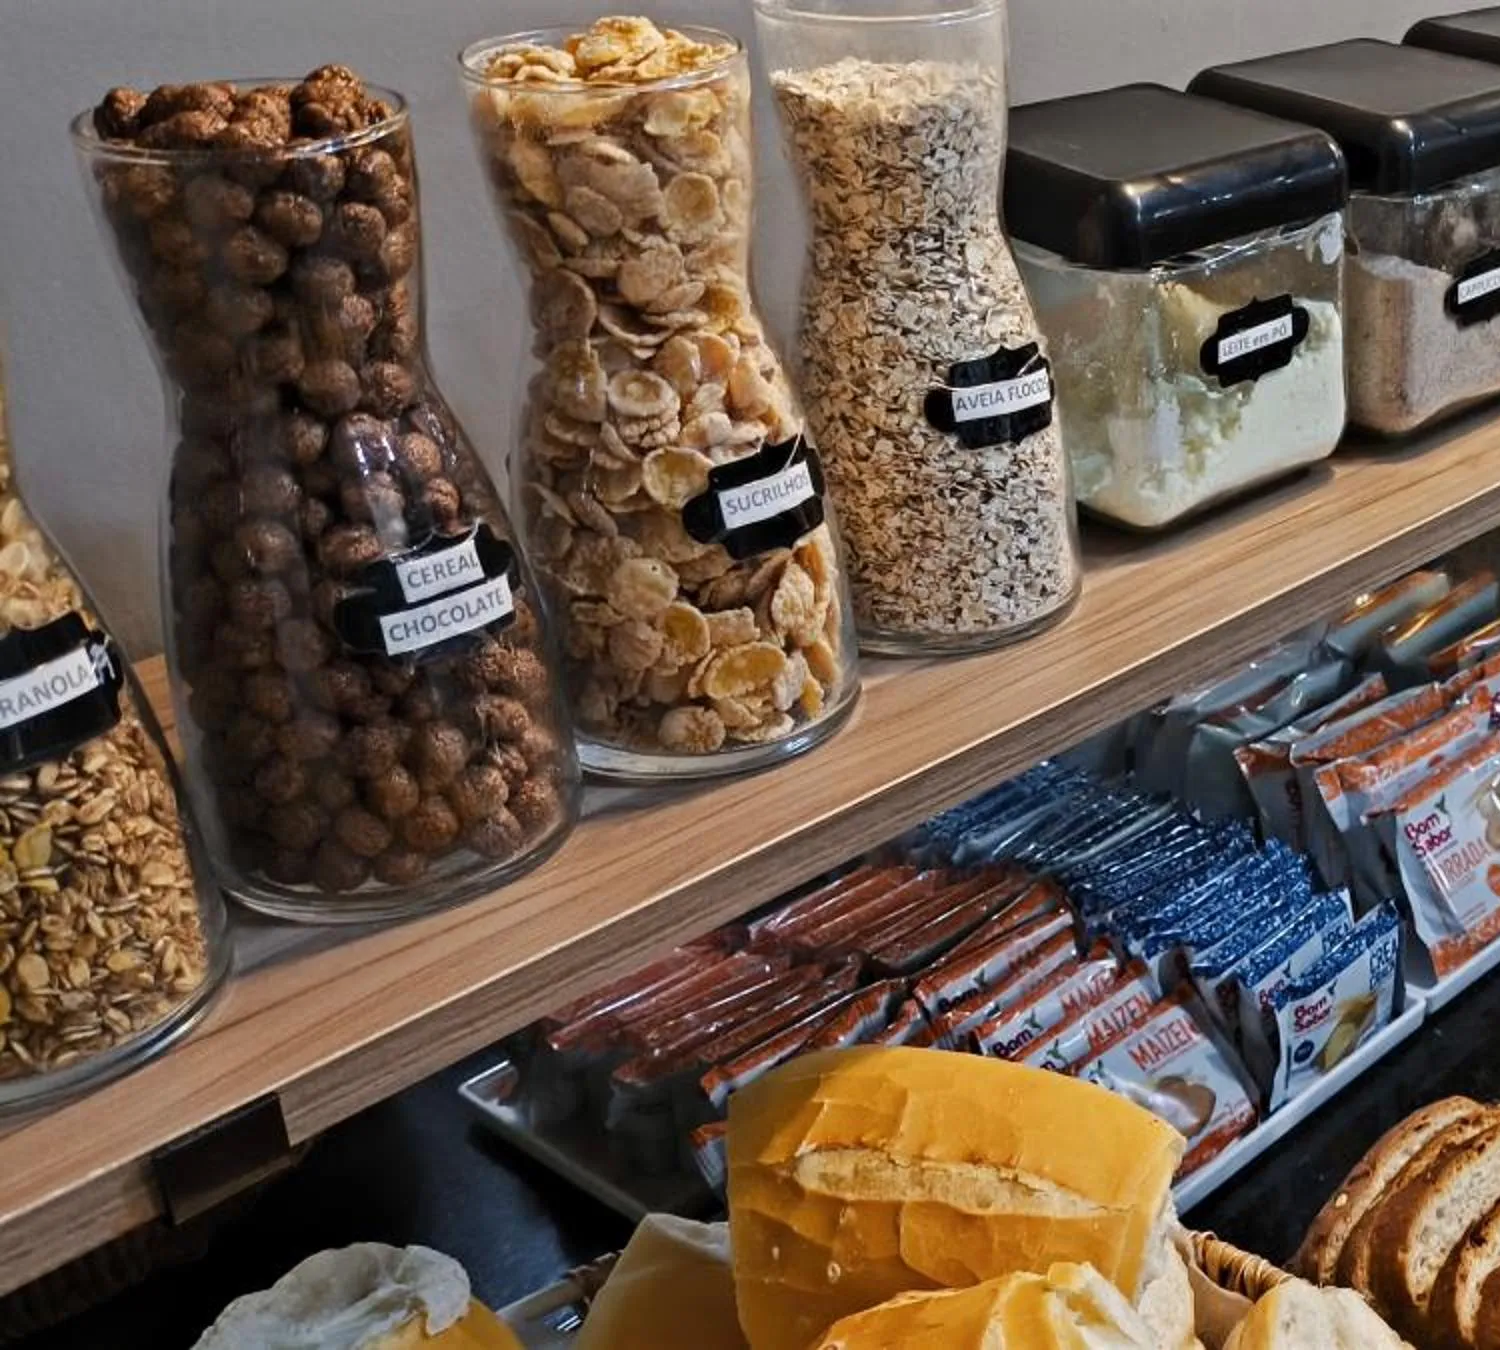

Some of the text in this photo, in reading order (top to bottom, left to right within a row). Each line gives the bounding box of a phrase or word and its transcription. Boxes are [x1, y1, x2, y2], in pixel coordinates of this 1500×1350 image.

[1222, 336, 1252, 357] LEITE
[955, 390, 1006, 412] AVEIA
[406, 550, 479, 589] CEREAL
[388, 588, 506, 643] CHOCOLATE
[0, 663, 94, 720] RANOLA
[1404, 813, 1441, 842] Bom
[1412, 826, 1453, 859] Sabor
[1294, 996, 1328, 1018] Bom
[992, 1028, 1034, 1057] Bom
